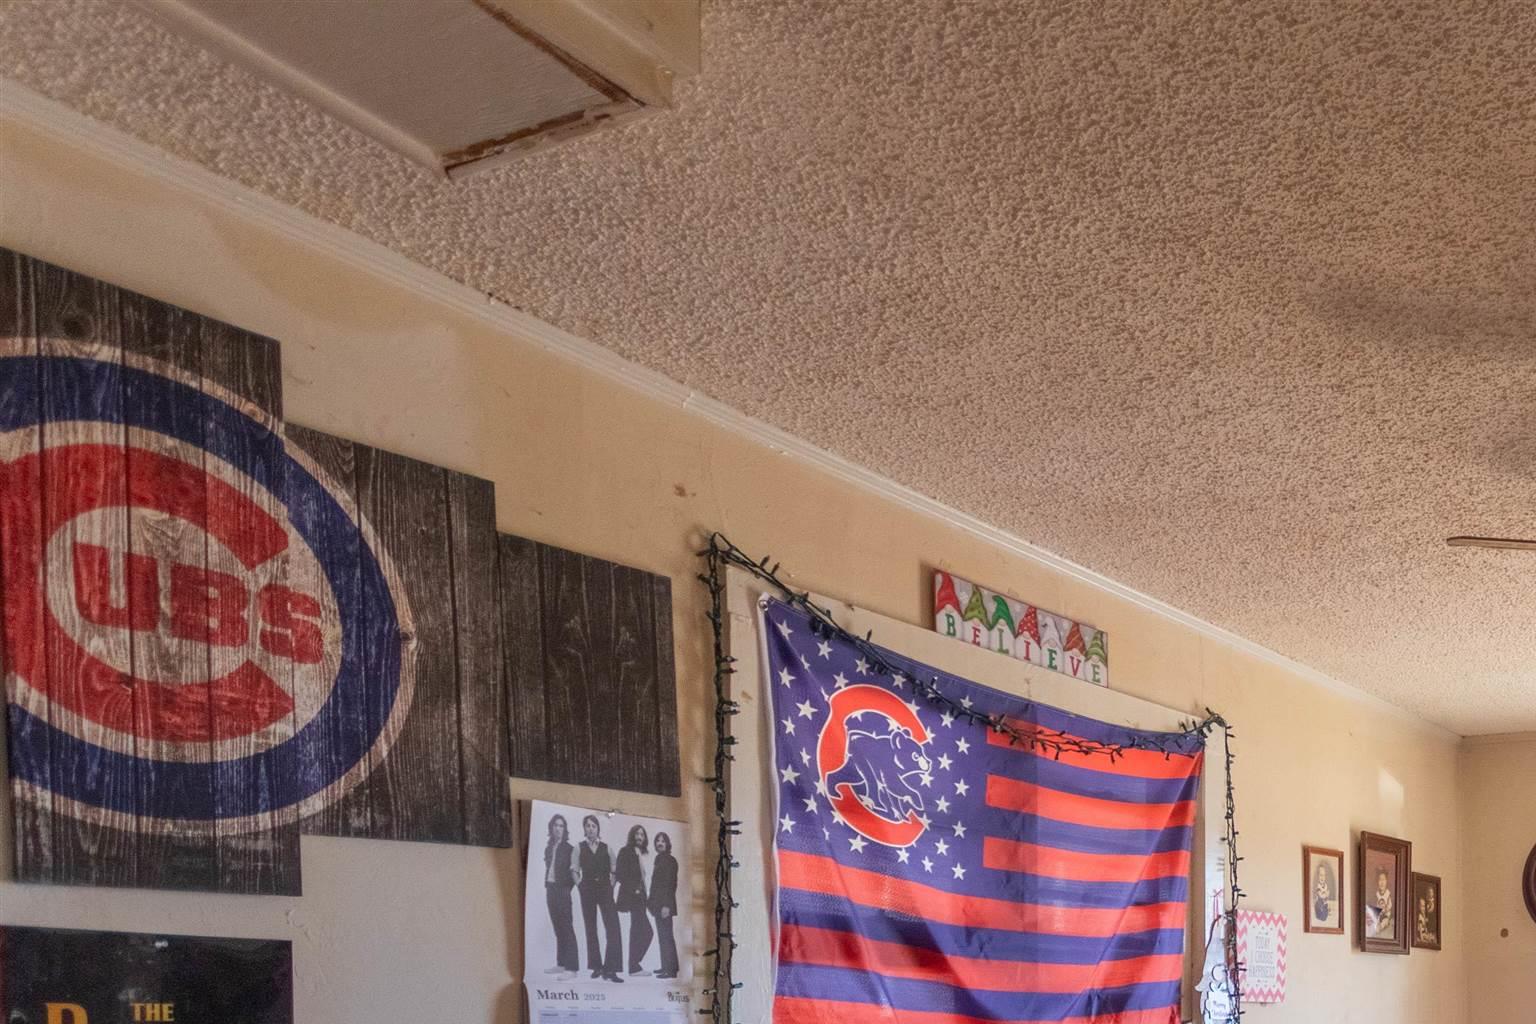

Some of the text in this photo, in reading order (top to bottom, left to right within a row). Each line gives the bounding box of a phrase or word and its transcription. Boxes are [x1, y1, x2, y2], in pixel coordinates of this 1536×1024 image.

[0, 442, 324, 743] CUBS
[944, 613, 1101, 683] BELIEVE
[131, 1003, 175, 1022] THE
[536, 989, 580, 1001] March
